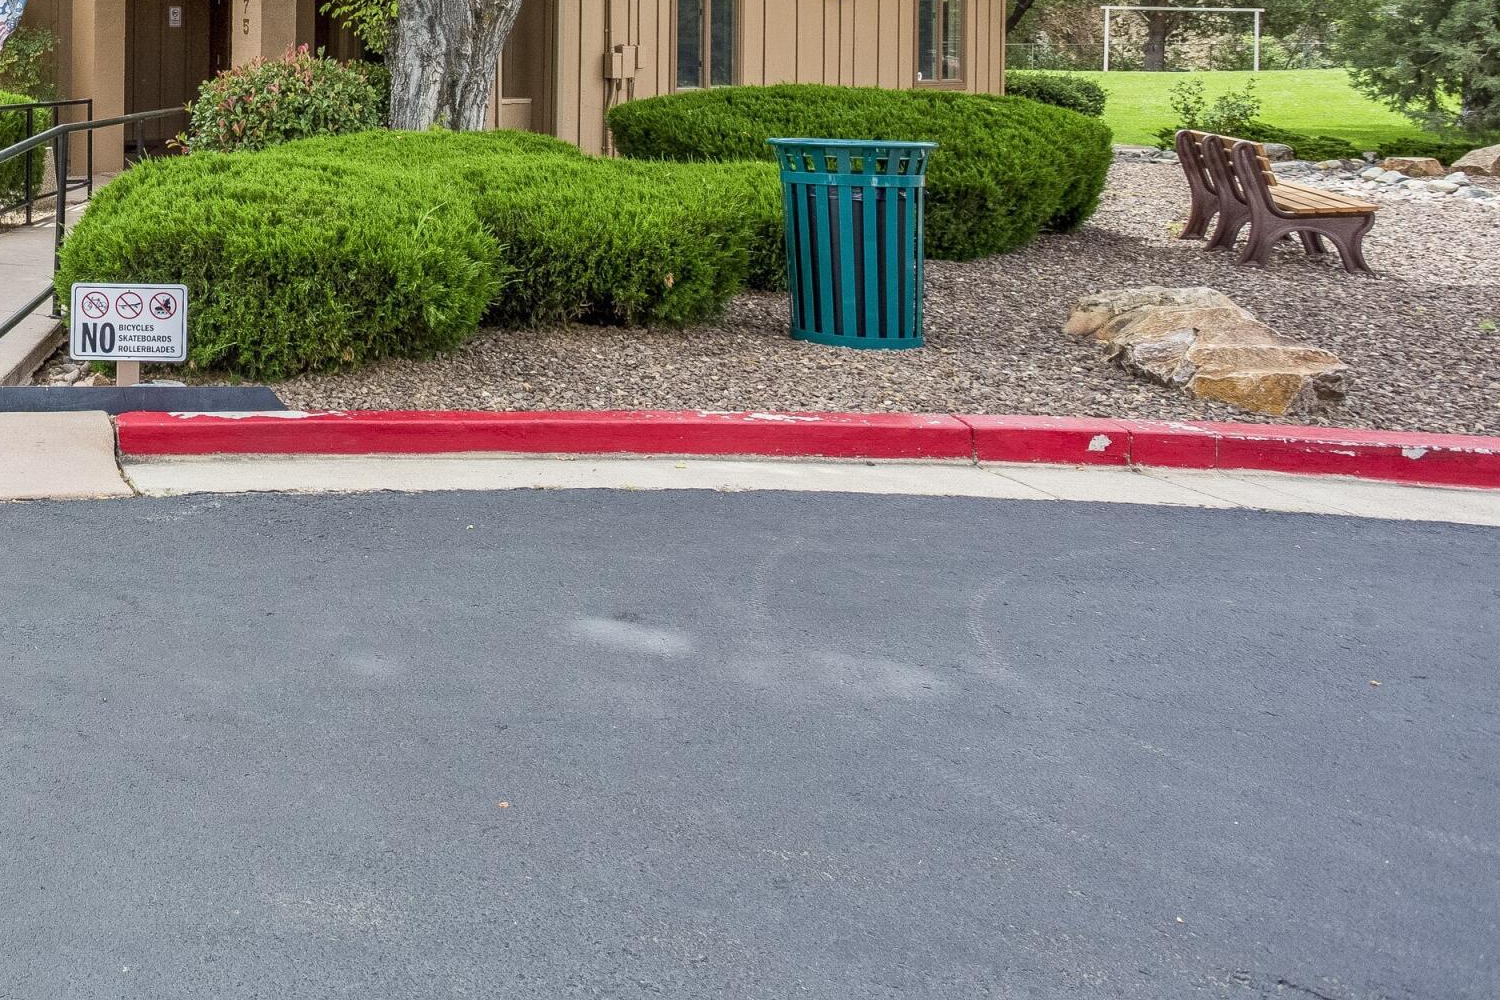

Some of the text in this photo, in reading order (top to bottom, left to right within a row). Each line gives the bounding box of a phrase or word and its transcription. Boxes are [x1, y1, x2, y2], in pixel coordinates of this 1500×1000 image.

[118, 324, 155, 332] BICYCLES
[81, 322, 116, 354] NO
[118, 334, 172, 343] SKATEBOARDS
[118, 345, 175, 354] ROLLERBLADES
